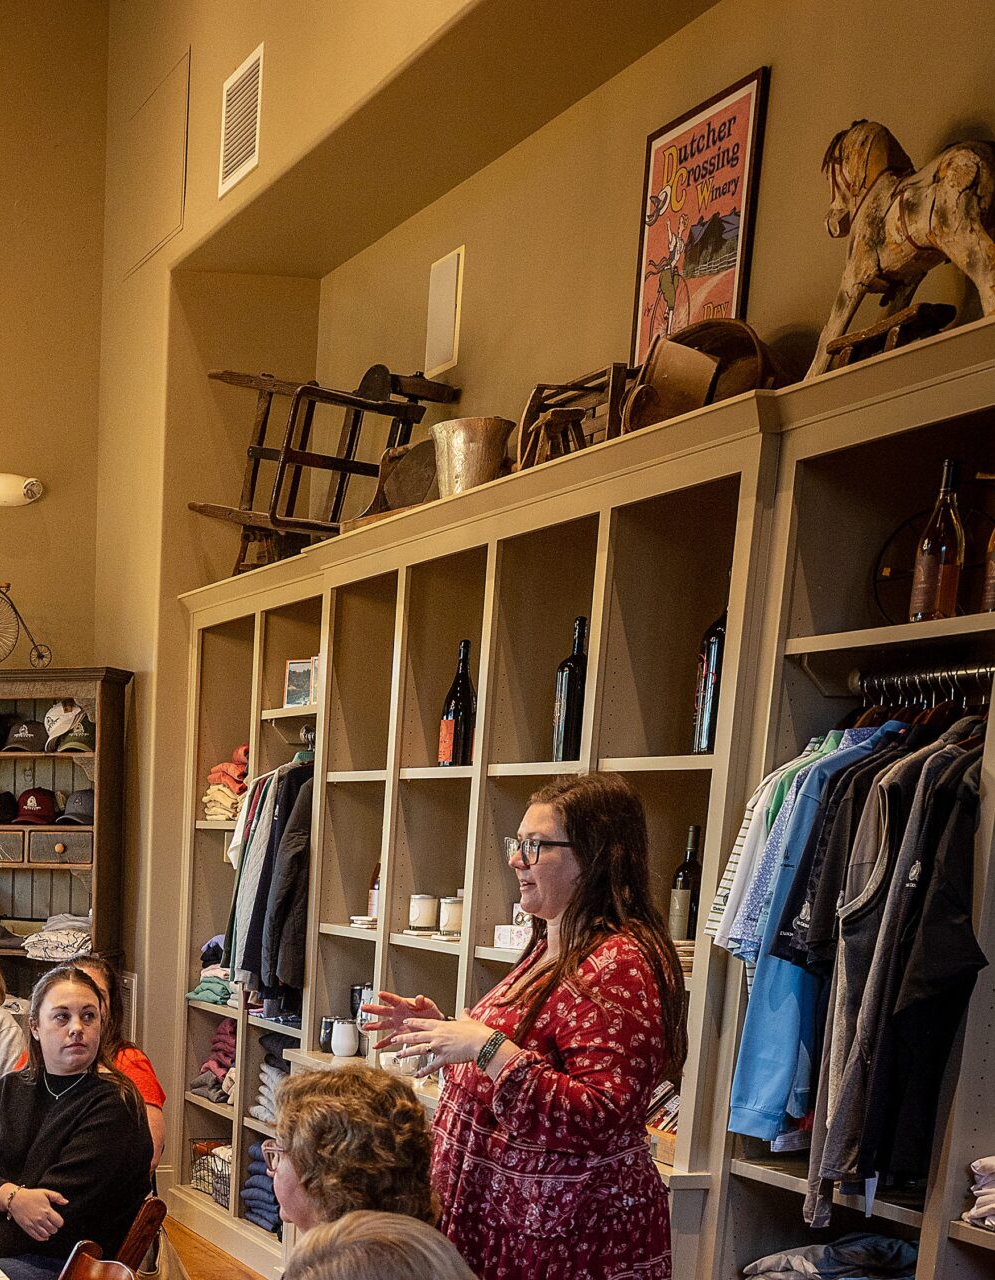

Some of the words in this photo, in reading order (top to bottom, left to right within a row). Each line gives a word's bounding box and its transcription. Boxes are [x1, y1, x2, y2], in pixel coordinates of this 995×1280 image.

[662, 115, 737, 190] Dutcher
[670, 142, 740, 213] Crossing
[696, 176, 740, 213] Winery
